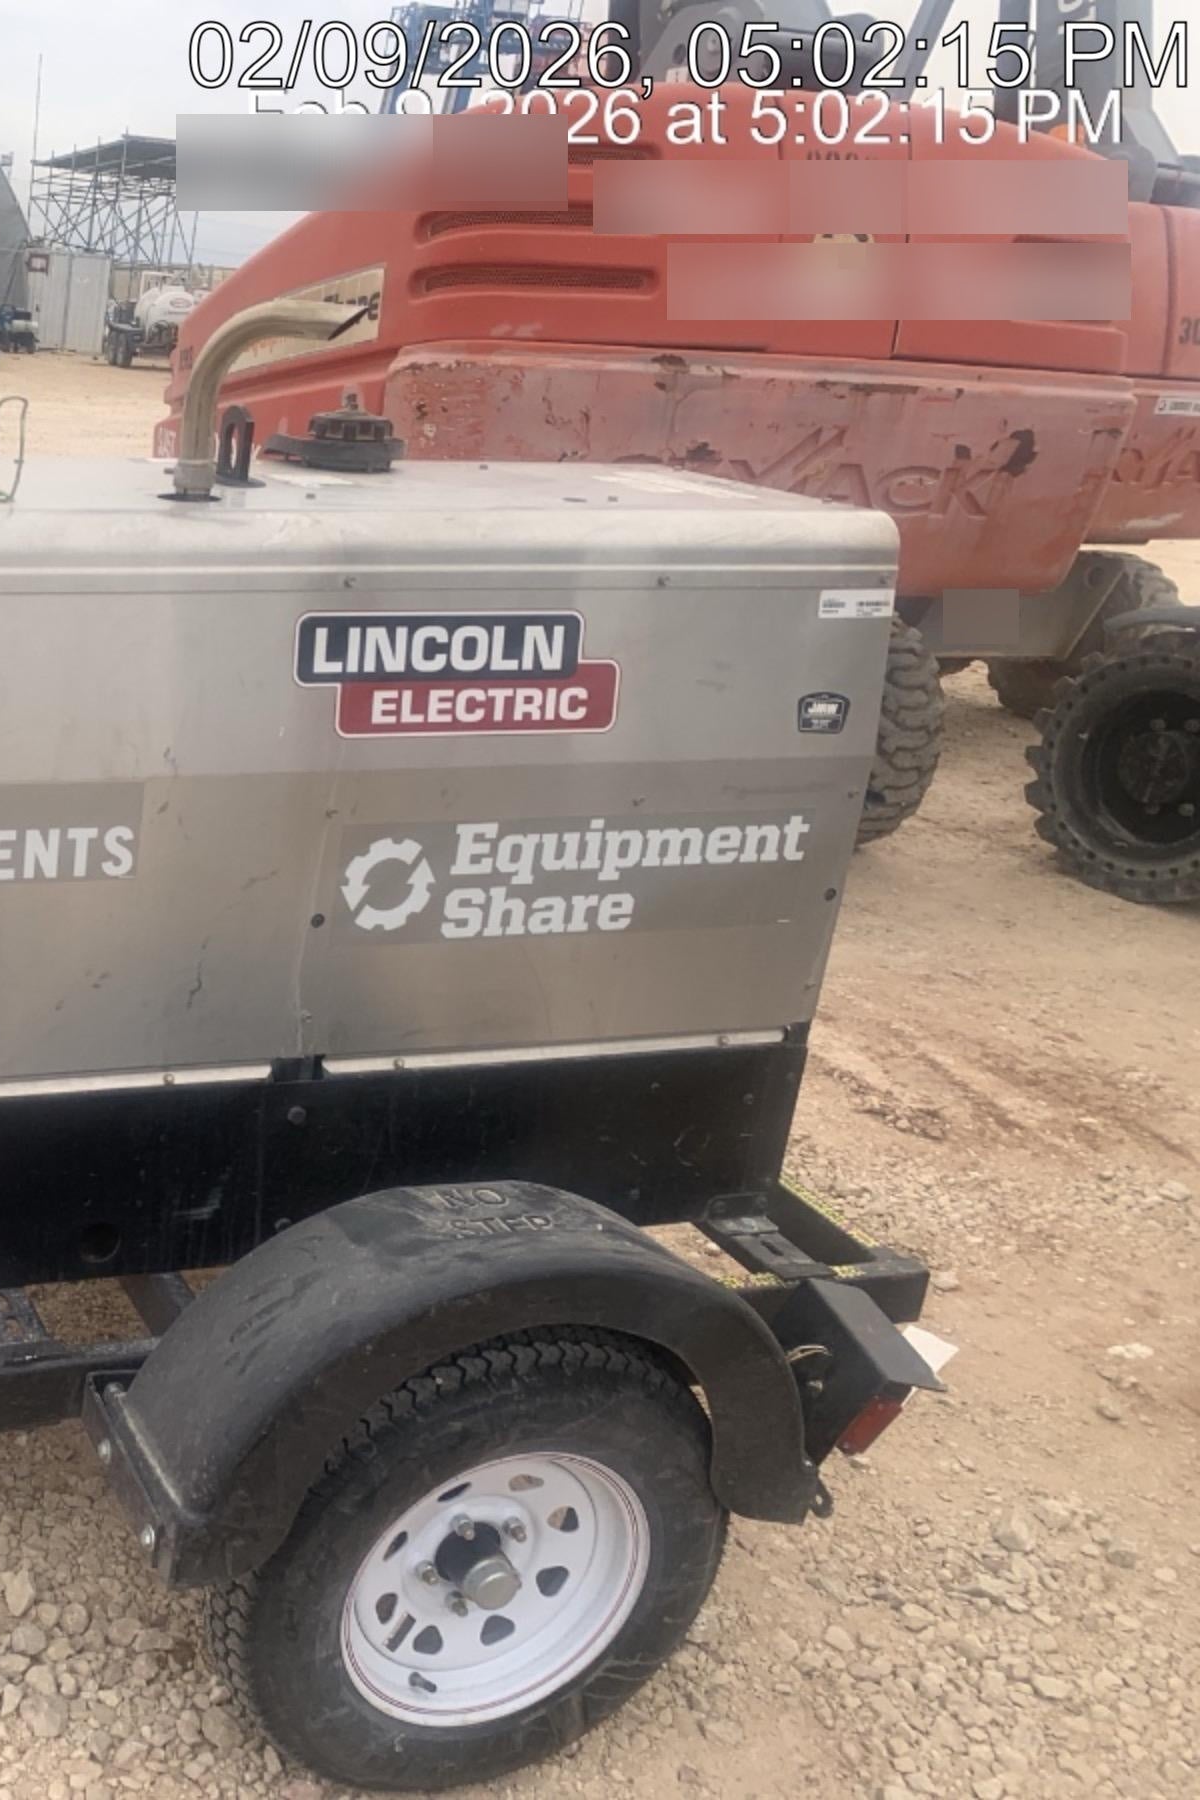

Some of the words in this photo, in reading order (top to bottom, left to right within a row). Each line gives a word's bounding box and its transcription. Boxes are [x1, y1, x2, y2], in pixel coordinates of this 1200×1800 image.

[313, 625, 565, 674] LINCOLN
[371, 687, 589, 725] ELECTRIC
[449, 815, 811, 886] Equipment
[440, 886, 636, 940] Share
